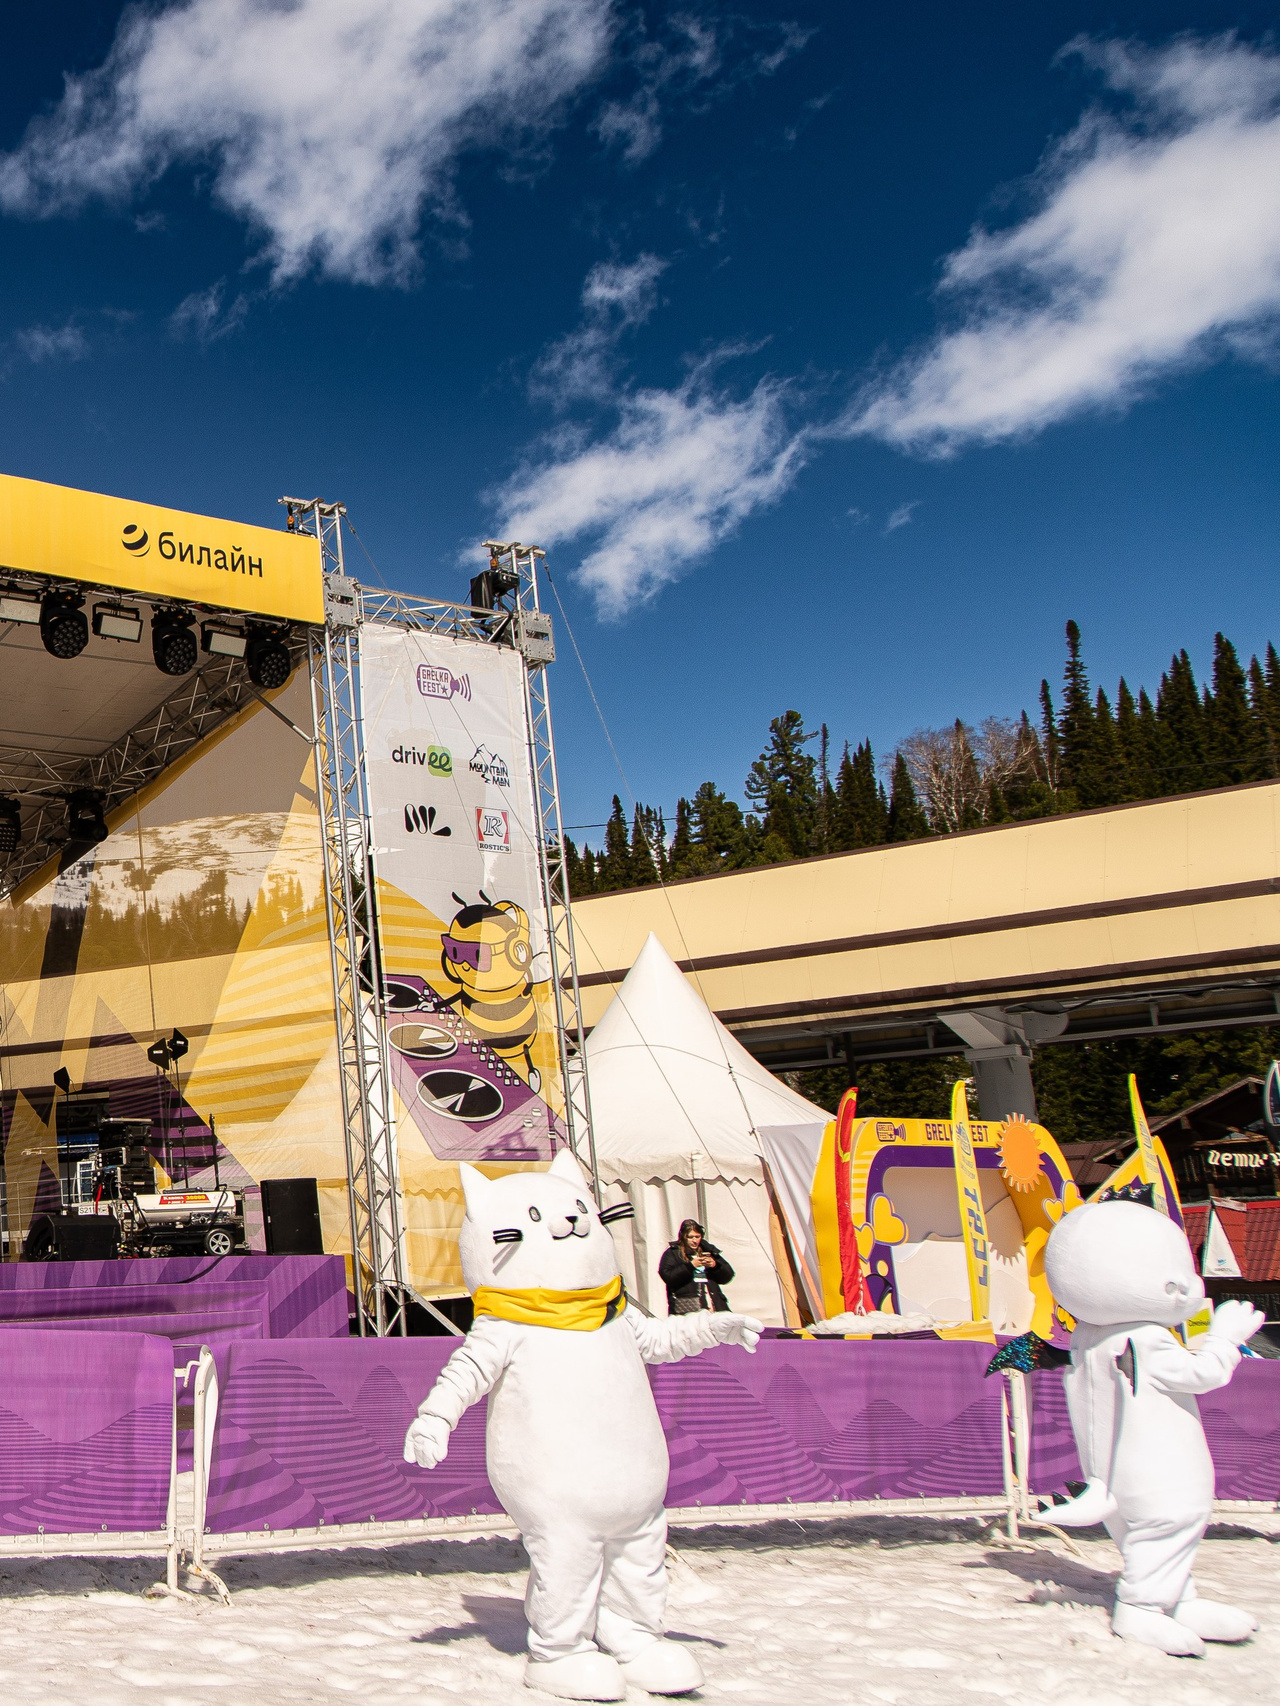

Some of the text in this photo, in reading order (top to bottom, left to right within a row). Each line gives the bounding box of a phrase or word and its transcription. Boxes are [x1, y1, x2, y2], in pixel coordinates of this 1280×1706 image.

[158, 531, 263, 578] билайн
[422, 669, 449, 683] GRELKA
[422, 681, 440, 693] FEST
[392, 745, 453, 772] drivee
[479, 843, 510, 852] ROSTIC'S
[925, 1123, 989, 1142] GRELEST
